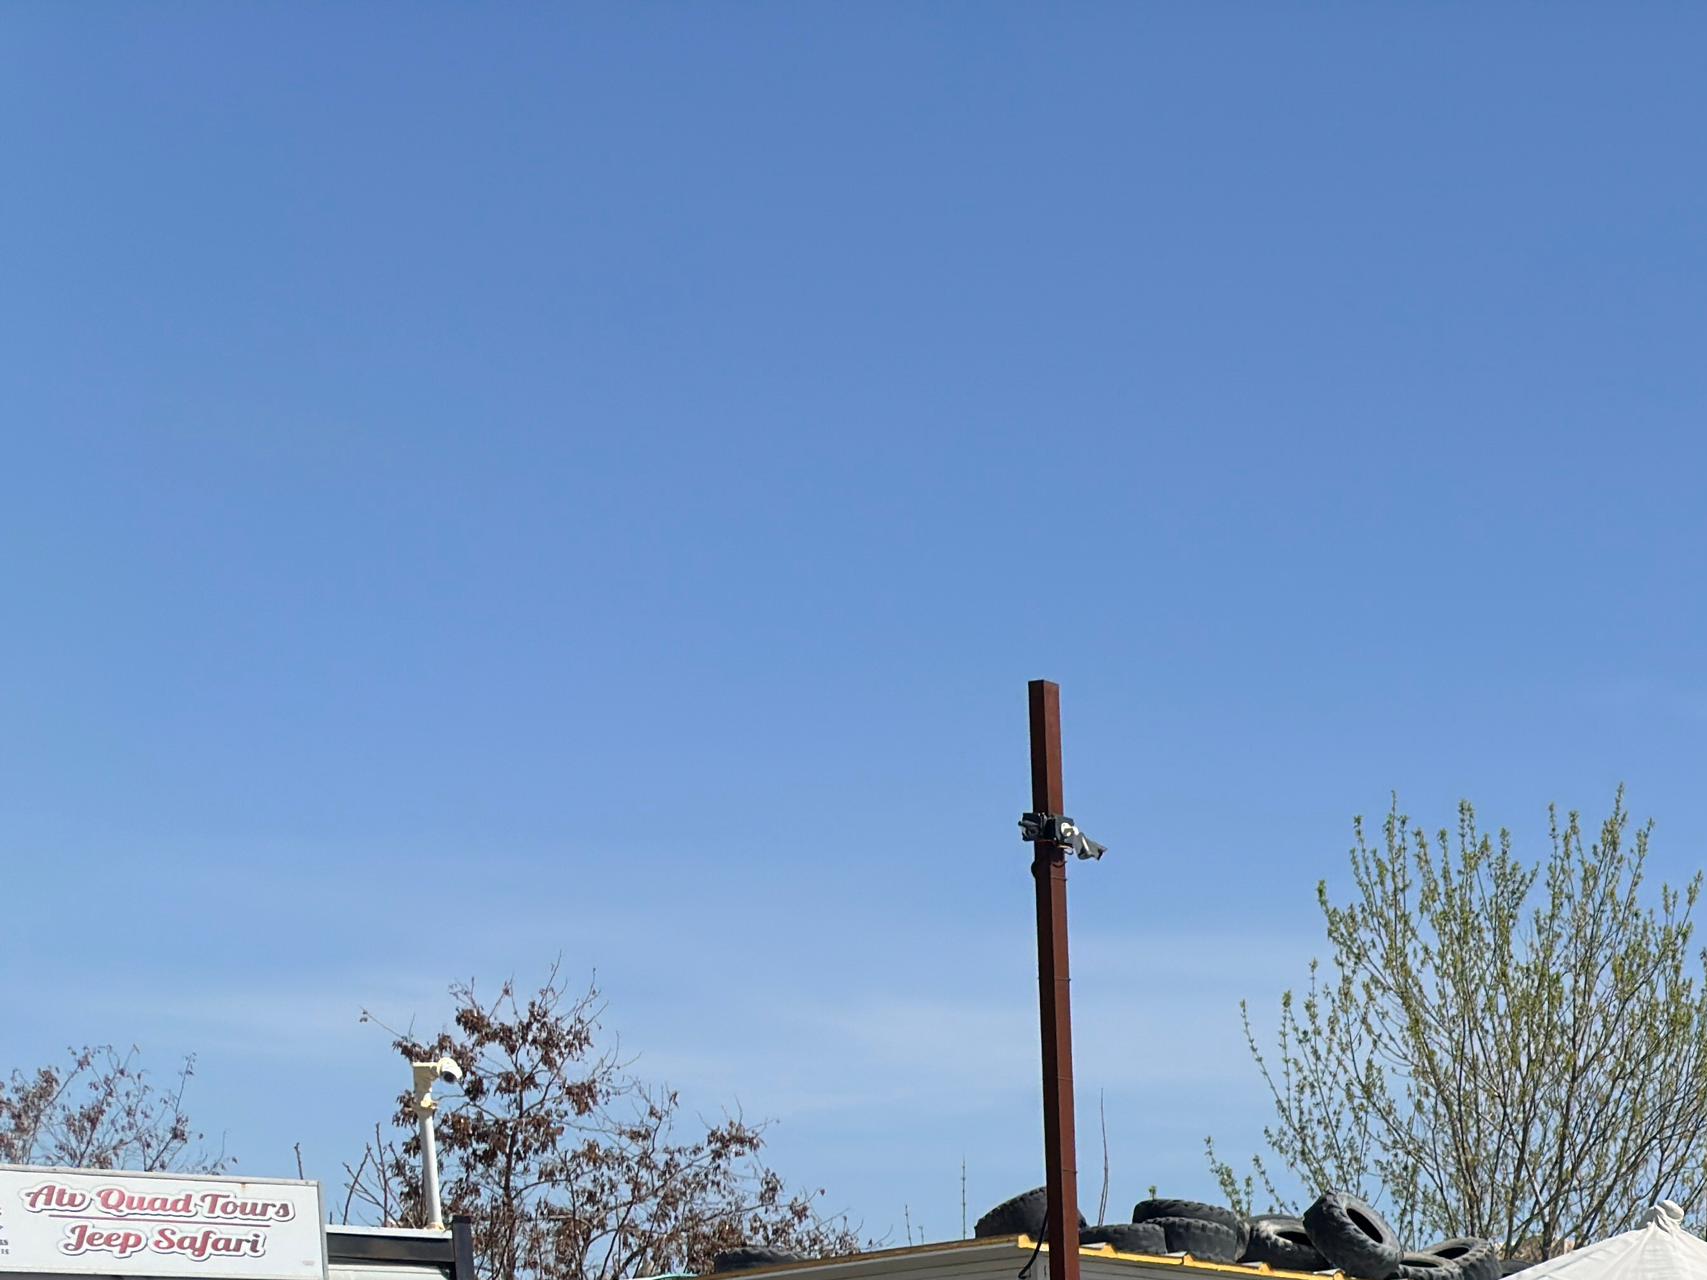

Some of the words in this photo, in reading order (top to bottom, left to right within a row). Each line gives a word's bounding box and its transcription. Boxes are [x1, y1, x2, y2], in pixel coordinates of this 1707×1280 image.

[25, 1183, 86, 1208] Atv
[96, 1187, 193, 1216] Quad
[198, 1192, 291, 1219] Tours
[63, 1224, 142, 1252] Jeep
[152, 1227, 264, 1259] Safari
